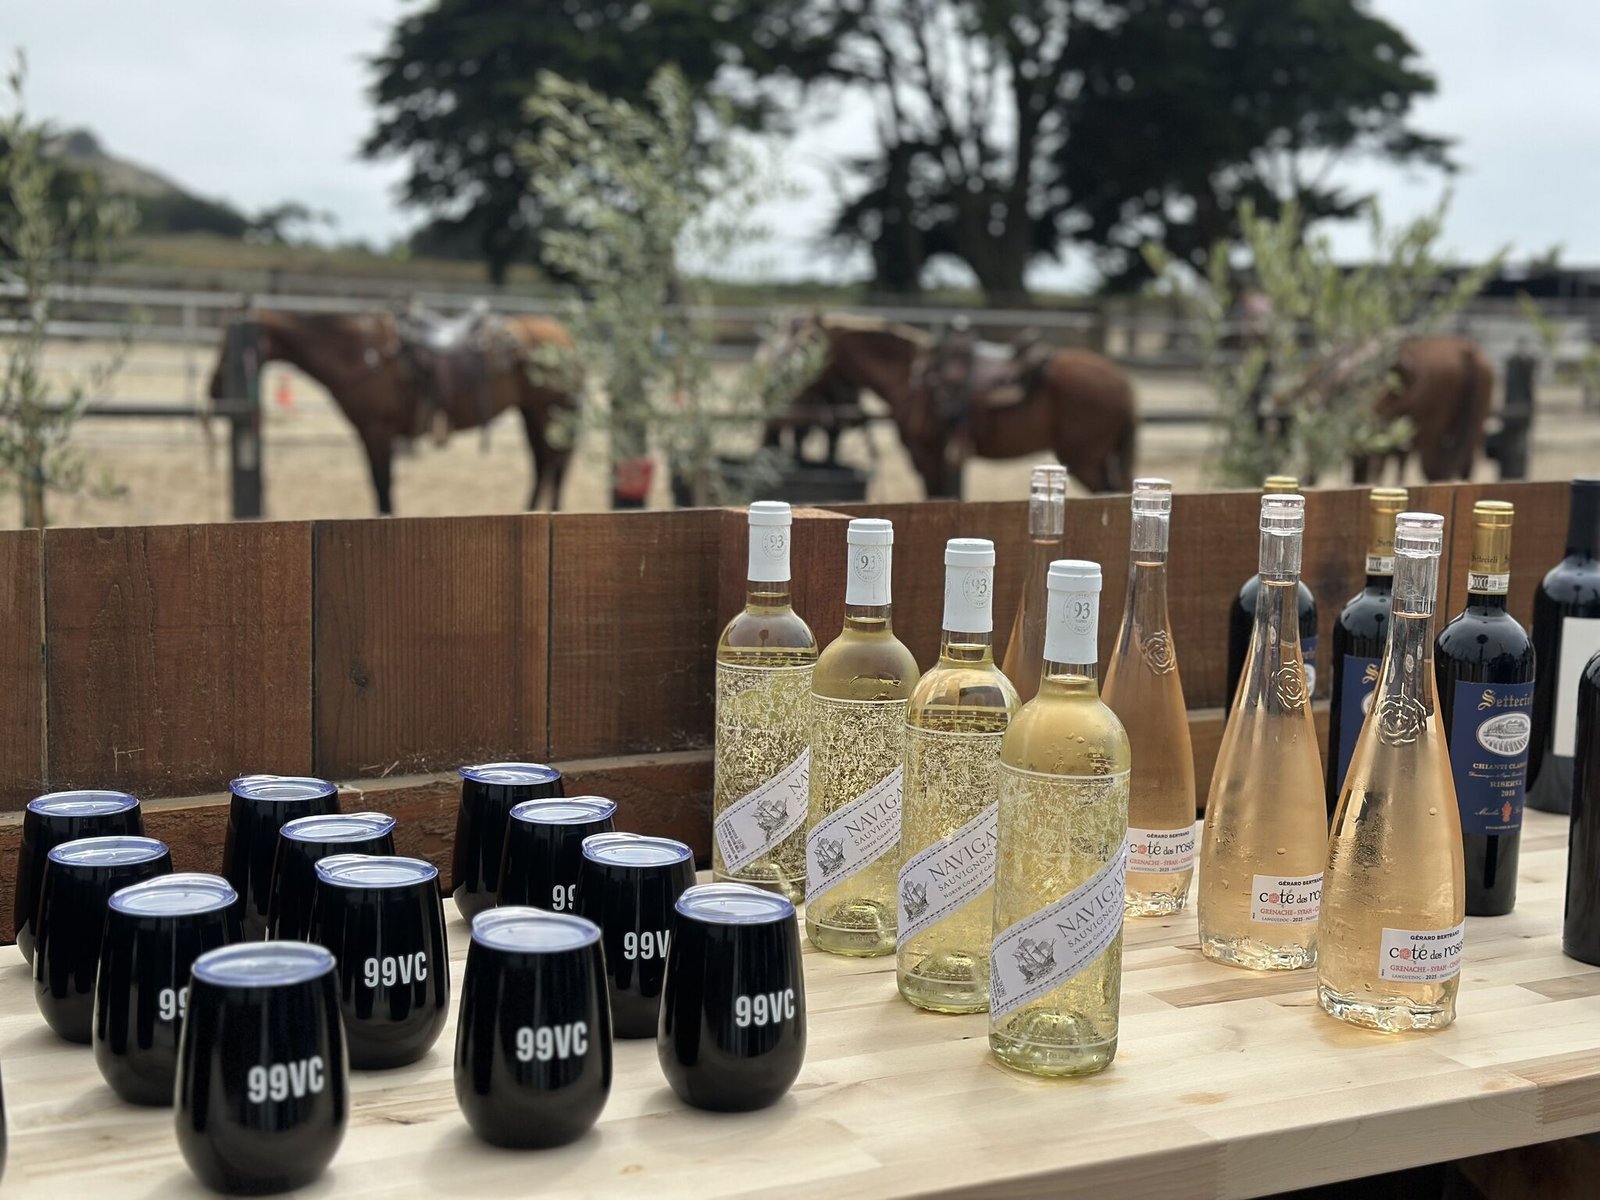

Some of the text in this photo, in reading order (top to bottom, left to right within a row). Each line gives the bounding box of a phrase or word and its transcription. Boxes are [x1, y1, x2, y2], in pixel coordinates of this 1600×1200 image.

[769, 534, 785, 549] 93
[860, 554, 876, 570] 93
[971, 577, 988, 595] 93
[1073, 601, 1091, 620] 93
[938, 849, 994, 892] SAUVIGNON
[1129, 857, 1160, 866] GRENACHE
[943, 886, 963, 899] NORTH
[962, 873, 979, 888] COAST
[1260, 907, 1294, 916] GRENACHE
[1067, 900, 1119, 948] SAUVIGNON
[1436, 929, 1460, 941] BERTRAND
[1073, 938, 1093, 956] NORTH
[1092, 925, 1108, 941] COAST
[363, 951, 428, 988] 99VC
[1390, 964, 1427, 973] GRENACHE
[1430, 964, 1447, 973] SYRAH
[735, 988, 795, 1028] 99VC
[515, 1021, 588, 1062] 99VC
[247, 1055, 325, 1104] 99VC
